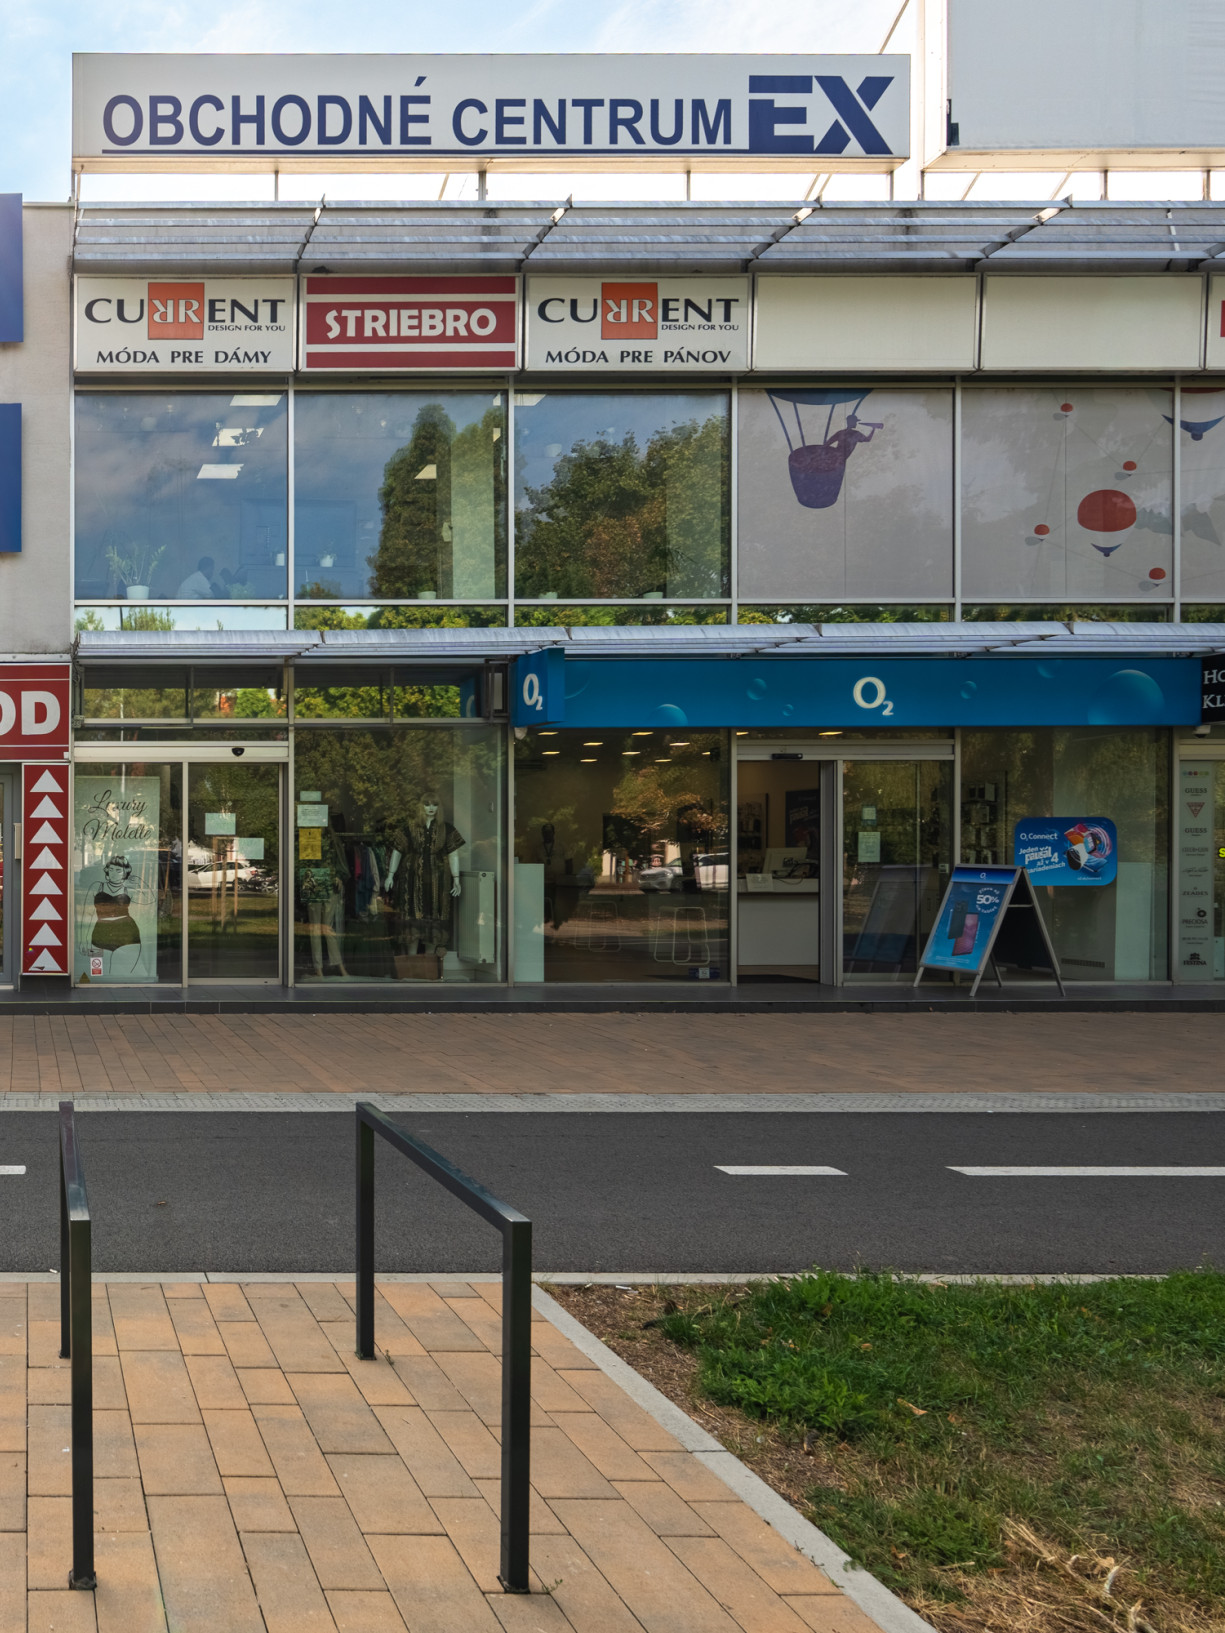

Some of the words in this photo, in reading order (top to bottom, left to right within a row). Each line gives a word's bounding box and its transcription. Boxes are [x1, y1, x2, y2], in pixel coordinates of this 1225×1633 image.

[102, 76, 432, 147] OBCHODNÉ
[451, 98, 733, 146] CENTRUM
[748, 75, 895, 155] EX
[207, 324, 242, 332] DESIGN
[244, 324, 263, 332] FOR
[264, 324, 286, 332] YOU
[325, 308, 497, 340] STRIEBRO
[96, 347, 160, 364] MÓDA
[170, 350, 204, 364] PRE
[214, 347, 272, 364] DÁMY
[545, 347, 608, 364] MÓDA
[619, 350, 654, 363] PRE
[663, 347, 732, 363] PÁNOV
[1028, 832, 1058, 840] Connect
[1018, 845, 1039, 855] Jeden
[976, 894, 1000, 905] 50%
